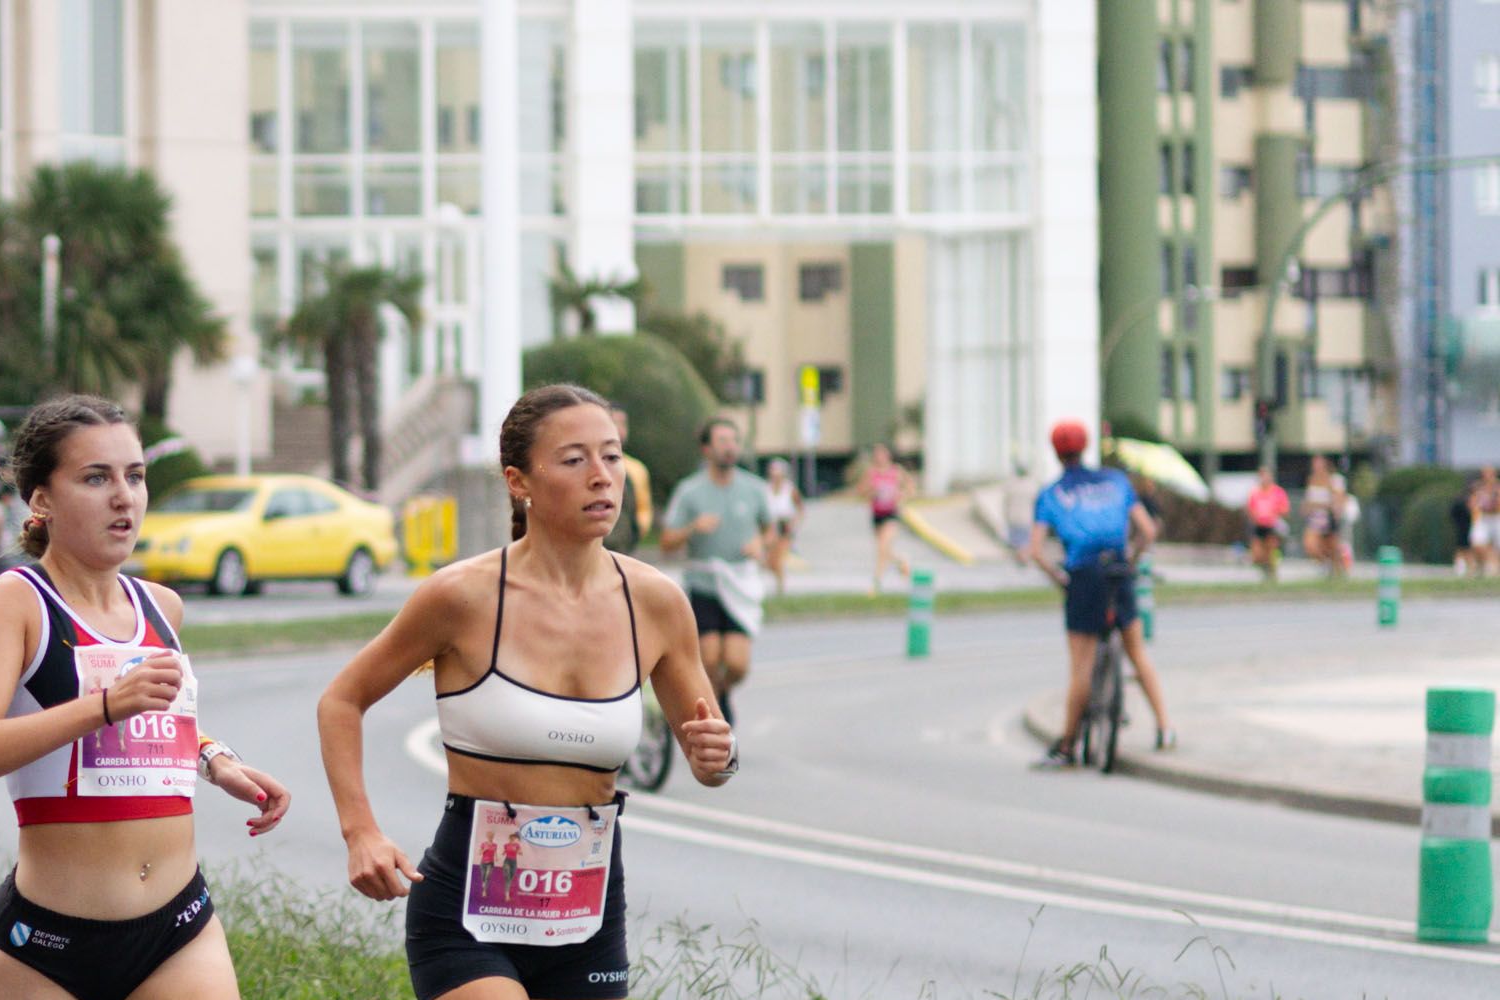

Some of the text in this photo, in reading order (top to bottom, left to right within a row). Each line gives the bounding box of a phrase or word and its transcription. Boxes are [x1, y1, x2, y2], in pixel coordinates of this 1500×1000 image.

[90, 659, 117, 669] SUMA
[130, 714, 177, 739] 016
[547, 730, 595, 744] OYSHO
[95, 757, 130, 767] CARRERA
[131, 757, 141, 767] DE
[141, 757, 151, 767] LA
[151, 757, 173, 767] MUJER
[98, 775, 147, 787] OYSHO
[524, 826, 578, 840] ASTURIANA
[518, 869, 573, 893] 016
[539, 897, 551, 908] 17
[479, 905, 513, 916] CARRERA
[514, 907, 525, 917] DE
[525, 908, 536, 917] LA
[536, 909, 561, 919] MUJER
[480, 922, 528, 936] OYSHO
[32, 937, 65, 950] GALEGO
[34, 929, 71, 945] DEPORTE
[588, 971, 628, 984] OYSHO
